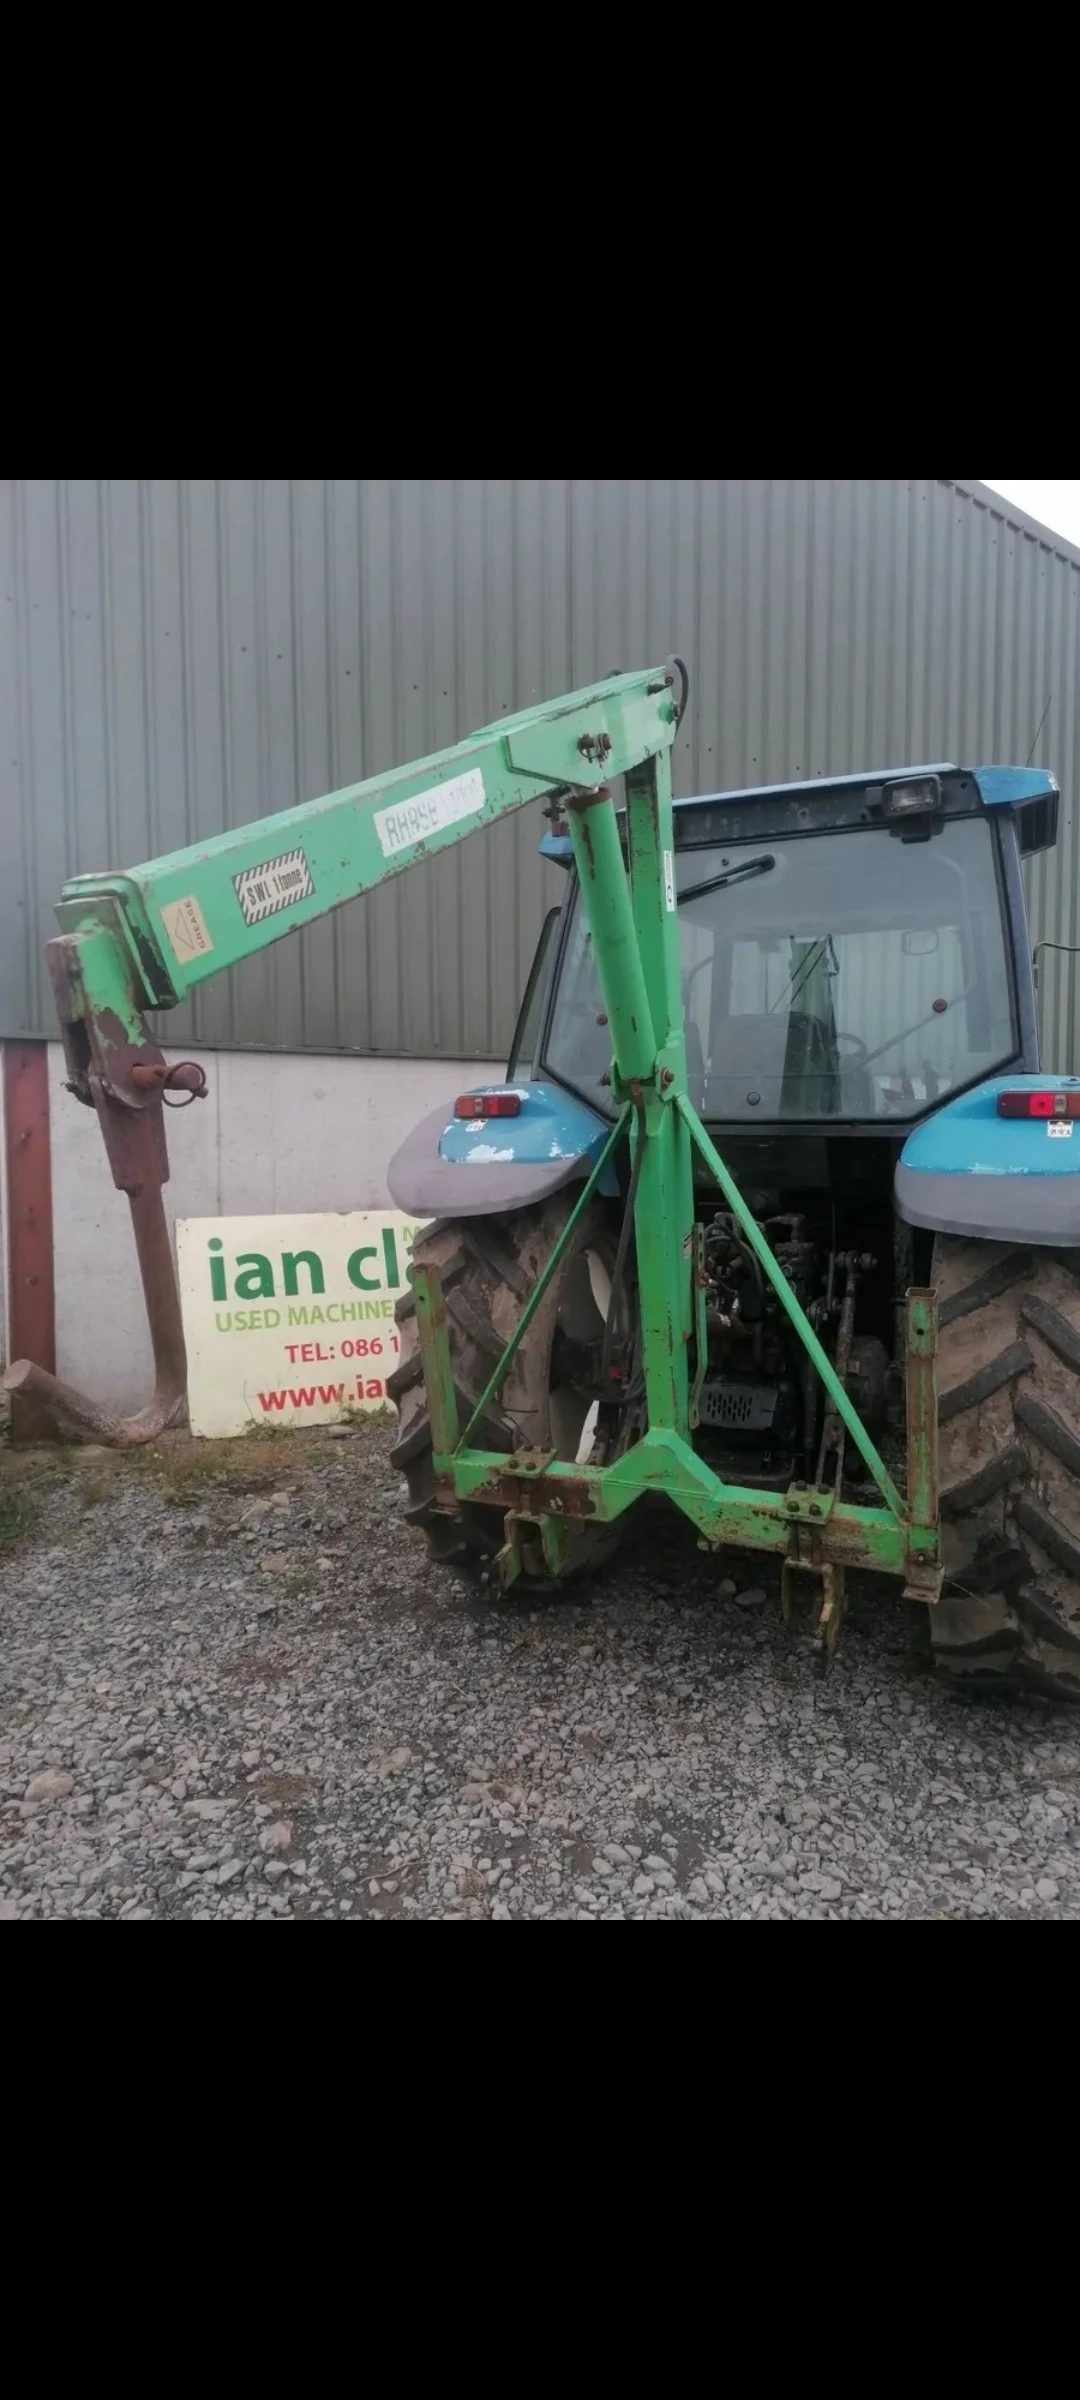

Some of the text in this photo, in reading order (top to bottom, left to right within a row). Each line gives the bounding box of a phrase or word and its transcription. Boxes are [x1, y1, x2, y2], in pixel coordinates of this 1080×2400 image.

[246, 881, 272, 906] SWL
[184, 900, 206, 949] GREASE
[208, 1237, 326, 1302] ian
[215, 1307, 281, 1333] USED
[284, 1342, 336, 1364] TEL:
[340, 1337, 384, 1359] 086
